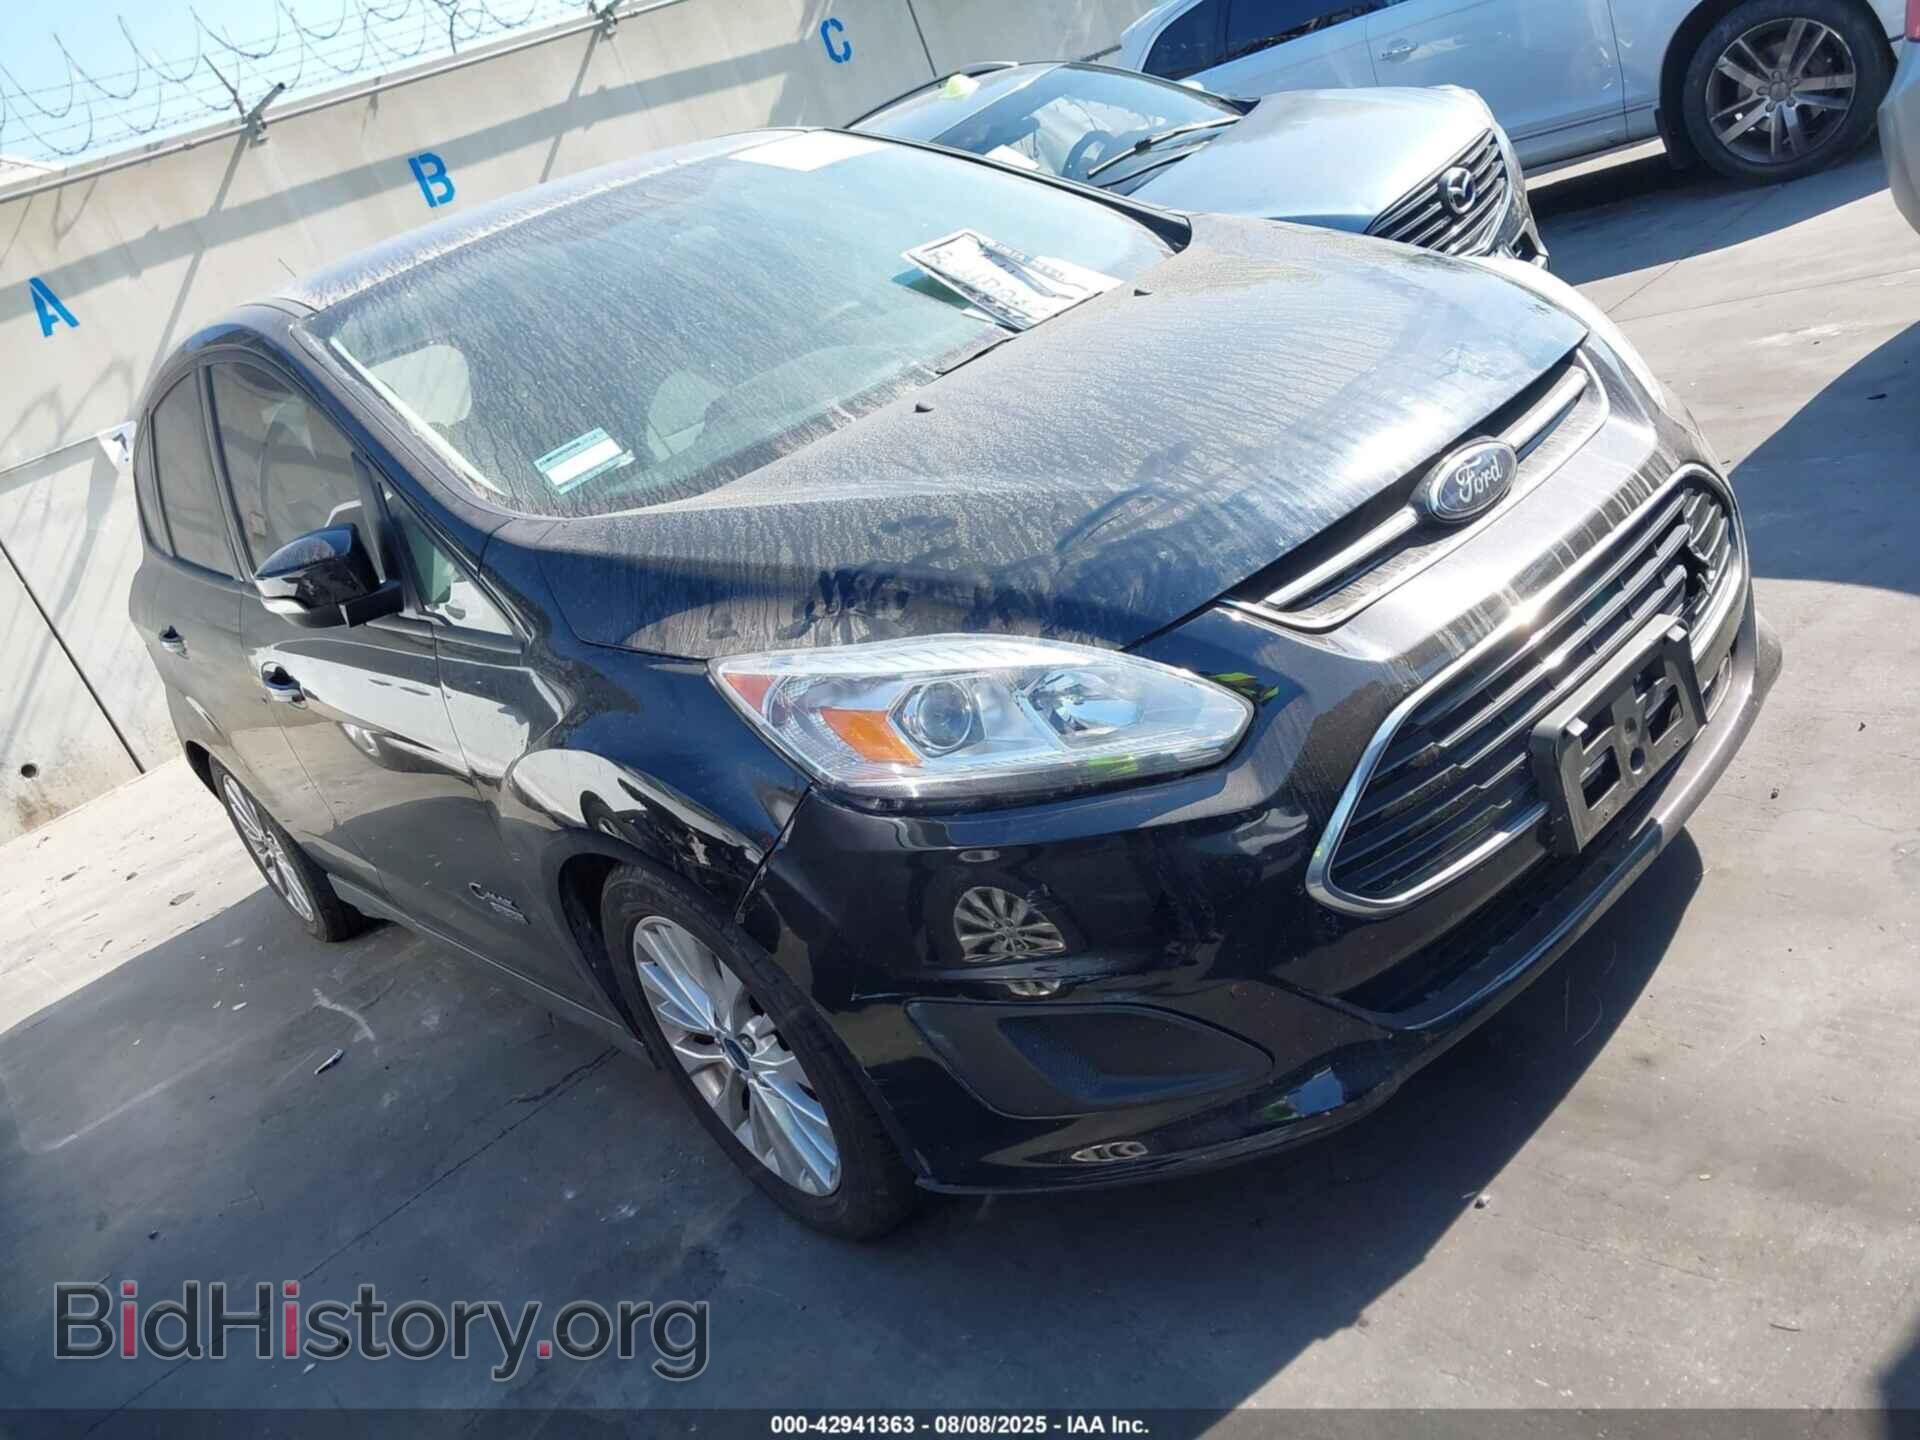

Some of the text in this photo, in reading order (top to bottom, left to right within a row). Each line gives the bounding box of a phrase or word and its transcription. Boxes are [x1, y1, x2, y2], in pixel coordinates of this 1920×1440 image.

[819, 17, 854, 65] C
[408, 152, 456, 208] B
[29, 277, 79, 337] A
[1455, 454, 1504, 503] Ford
